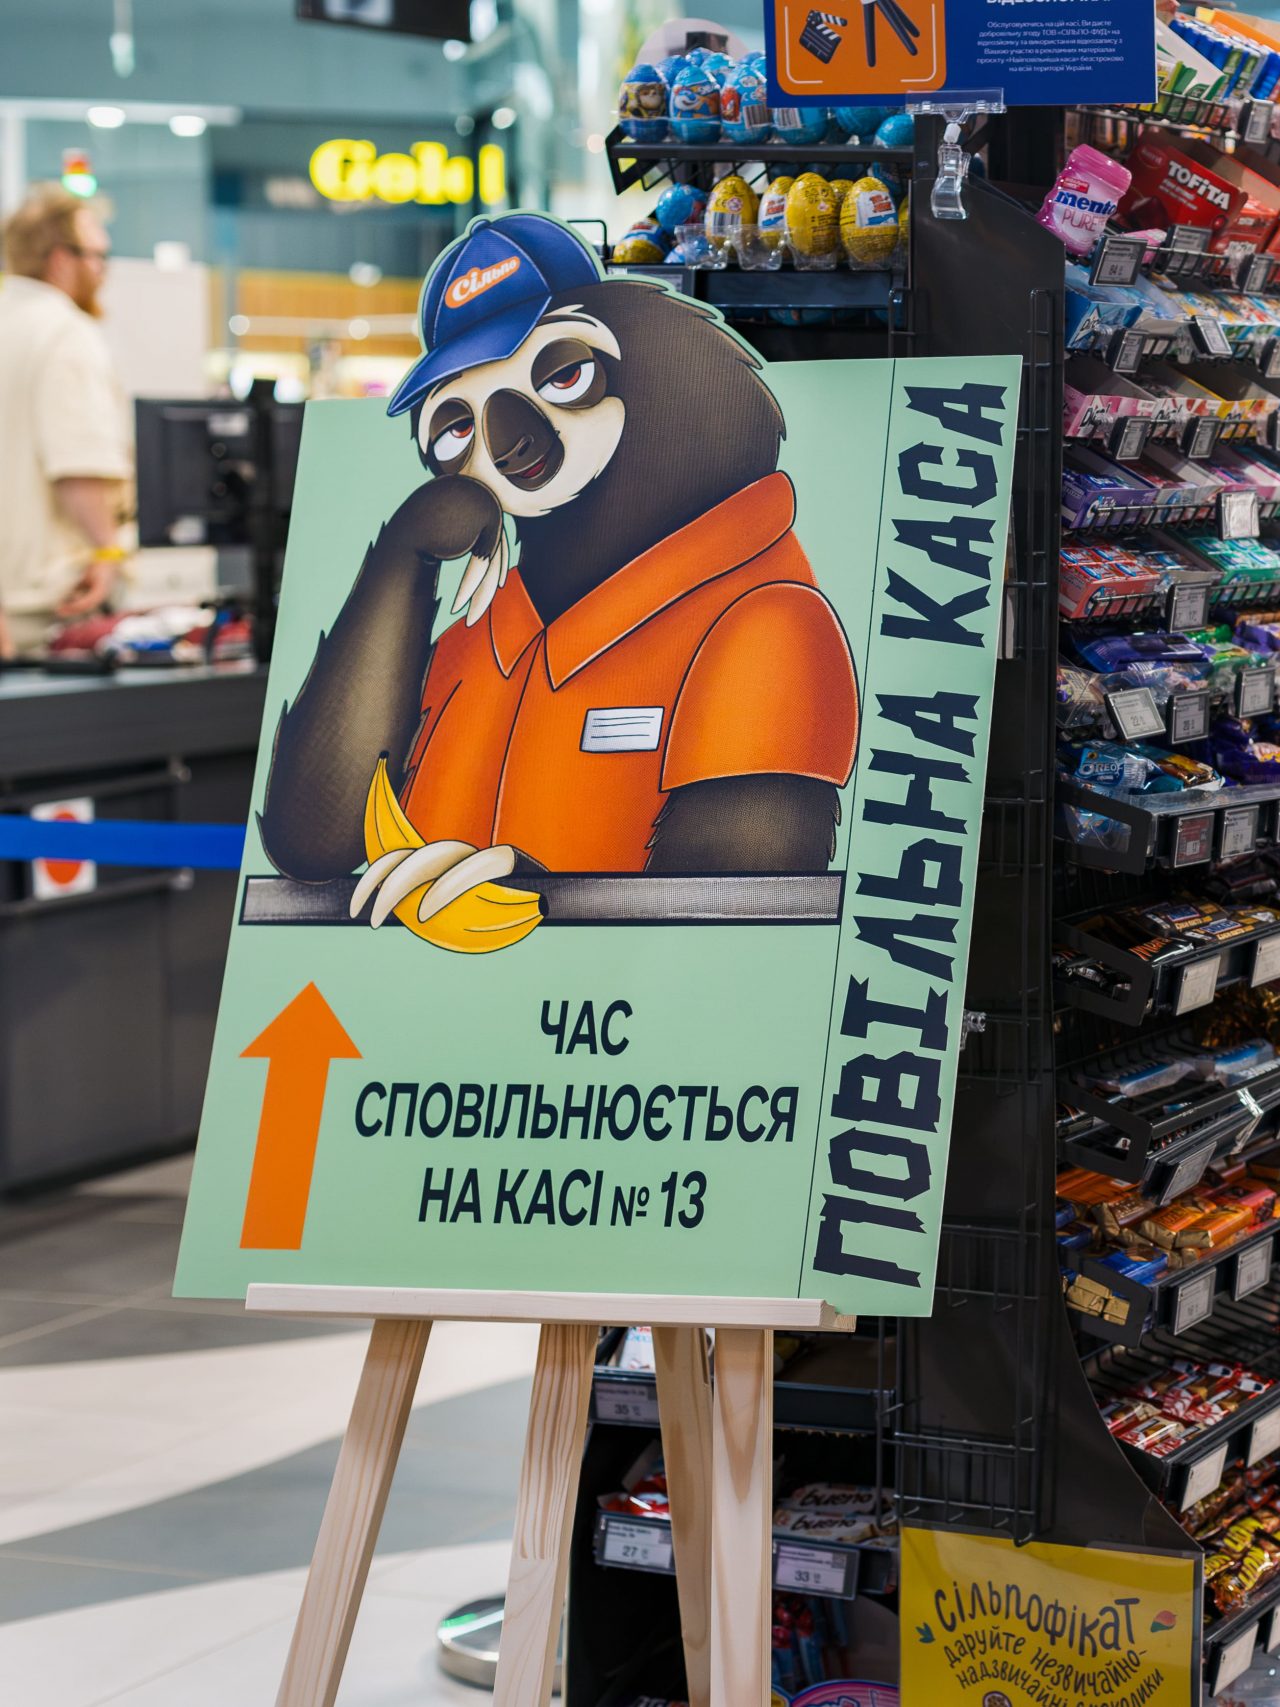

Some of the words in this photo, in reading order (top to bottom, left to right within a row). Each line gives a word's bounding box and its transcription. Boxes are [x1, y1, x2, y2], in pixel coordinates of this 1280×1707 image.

[452, 259, 518, 302] Сільпо
[879, 382, 1009, 648] КАСА
[812, 688, 983, 1290] ПОВІЛЬНА
[540, 999, 633, 1056] ЧАС
[355, 1081, 799, 1143] СПОВІЛЬНЮЄТЬСЯ
[418, 1167, 482, 1224] НА
[493, 1168, 604, 1227] КАСІ
[610, 1185, 650, 1227] №
[660, 1170, 708, 1229] 13
[790, 1515, 858, 1531] bueno
[800, 1488, 874, 1506] bueno
[621, 1545, 637, 1557] 27
[794, 1570, 810, 1582] 33
[943, 1626, 1026, 1669] даруйте
[1030, 1646, 1148, 1697] незвичайно-
